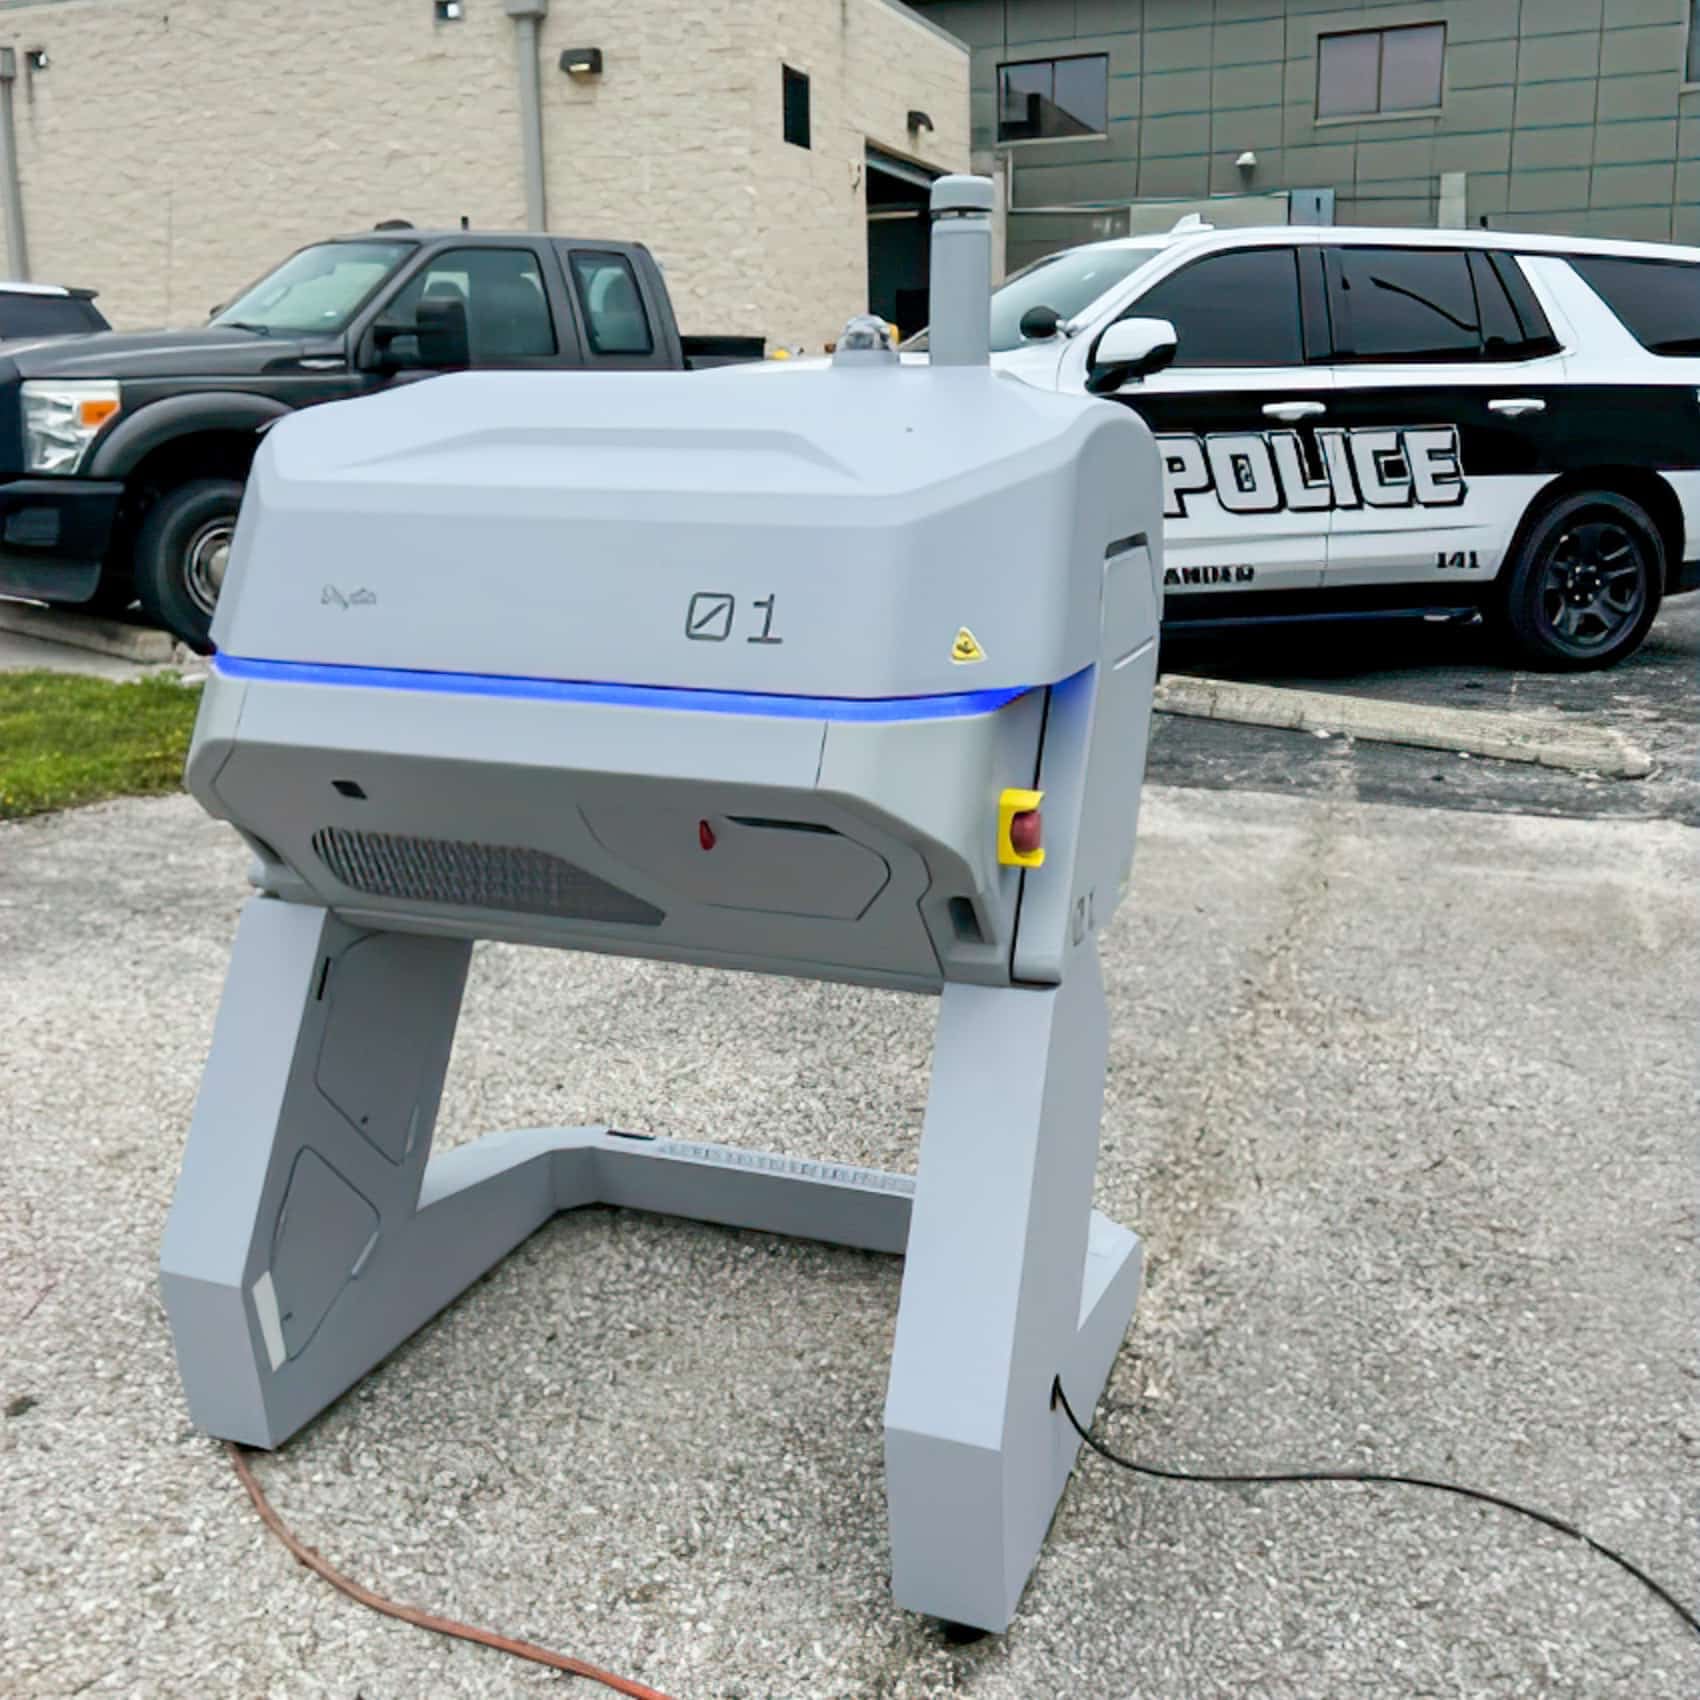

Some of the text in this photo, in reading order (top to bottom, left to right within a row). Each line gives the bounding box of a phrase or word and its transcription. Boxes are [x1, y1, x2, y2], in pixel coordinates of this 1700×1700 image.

[1155, 425, 1467, 518] POLICE
[1436, 551, 1480, 568] 141
[686, 592, 783, 645] 01
